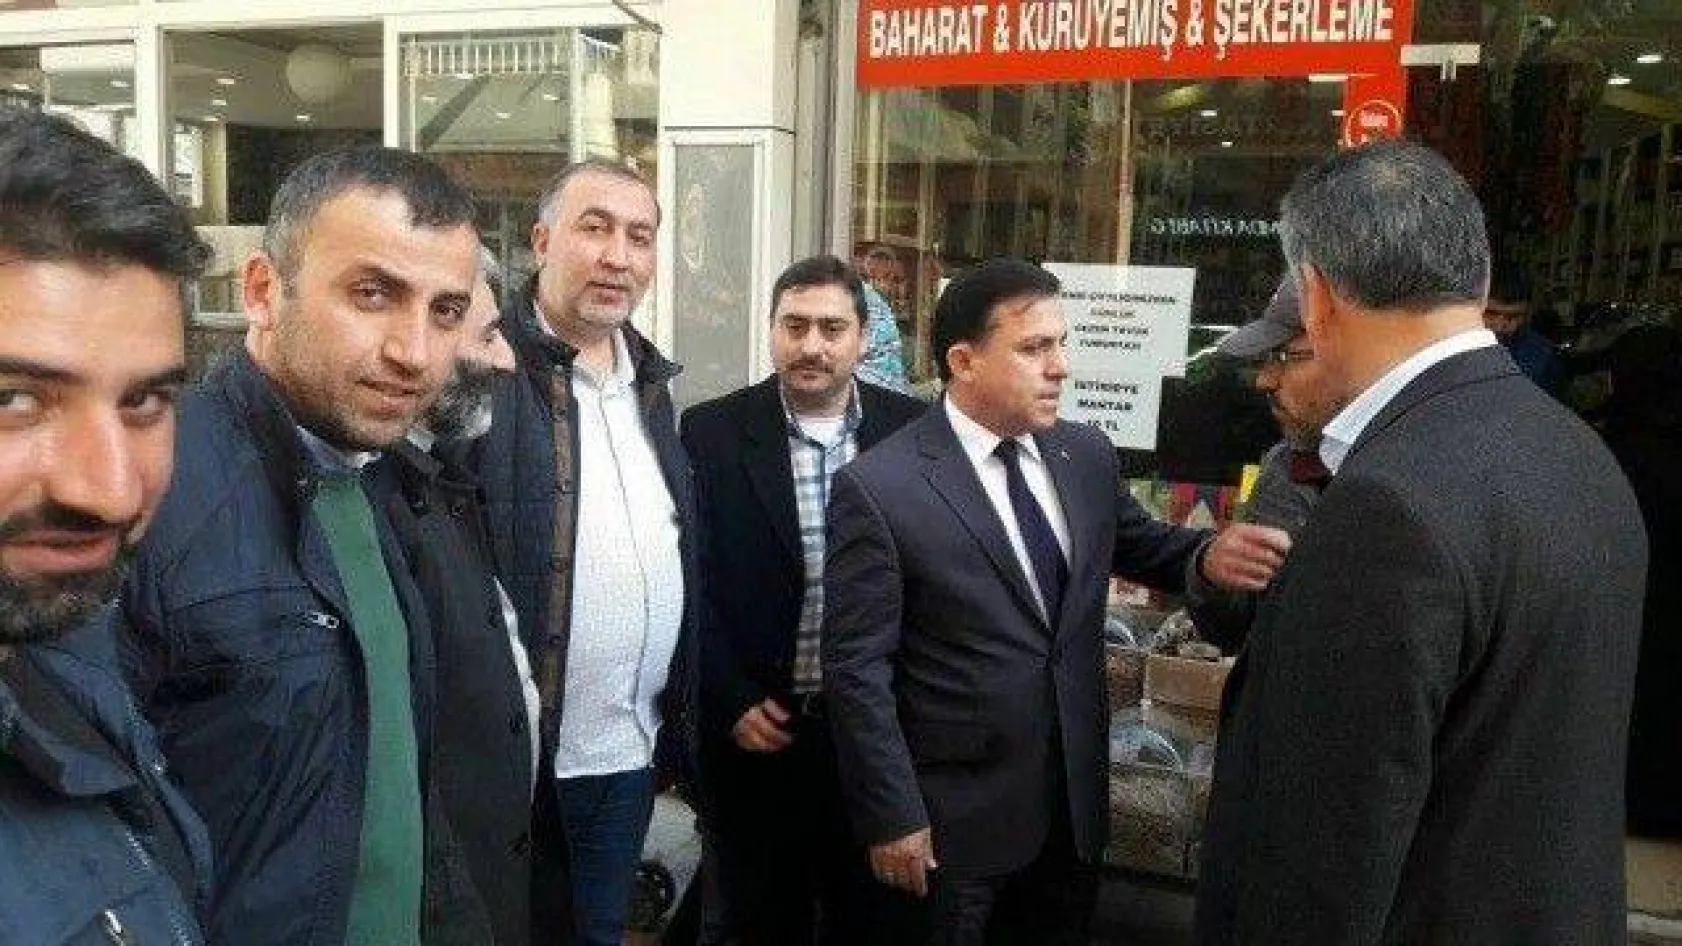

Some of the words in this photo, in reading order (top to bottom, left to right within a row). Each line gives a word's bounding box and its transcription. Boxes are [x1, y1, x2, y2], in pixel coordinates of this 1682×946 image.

[869, 5, 989, 58] BAHARAT
[993, 2, 1010, 53] &
[1185, 0, 1204, 46] &
[1213, 0, 1394, 60] ŞEKERLEME
